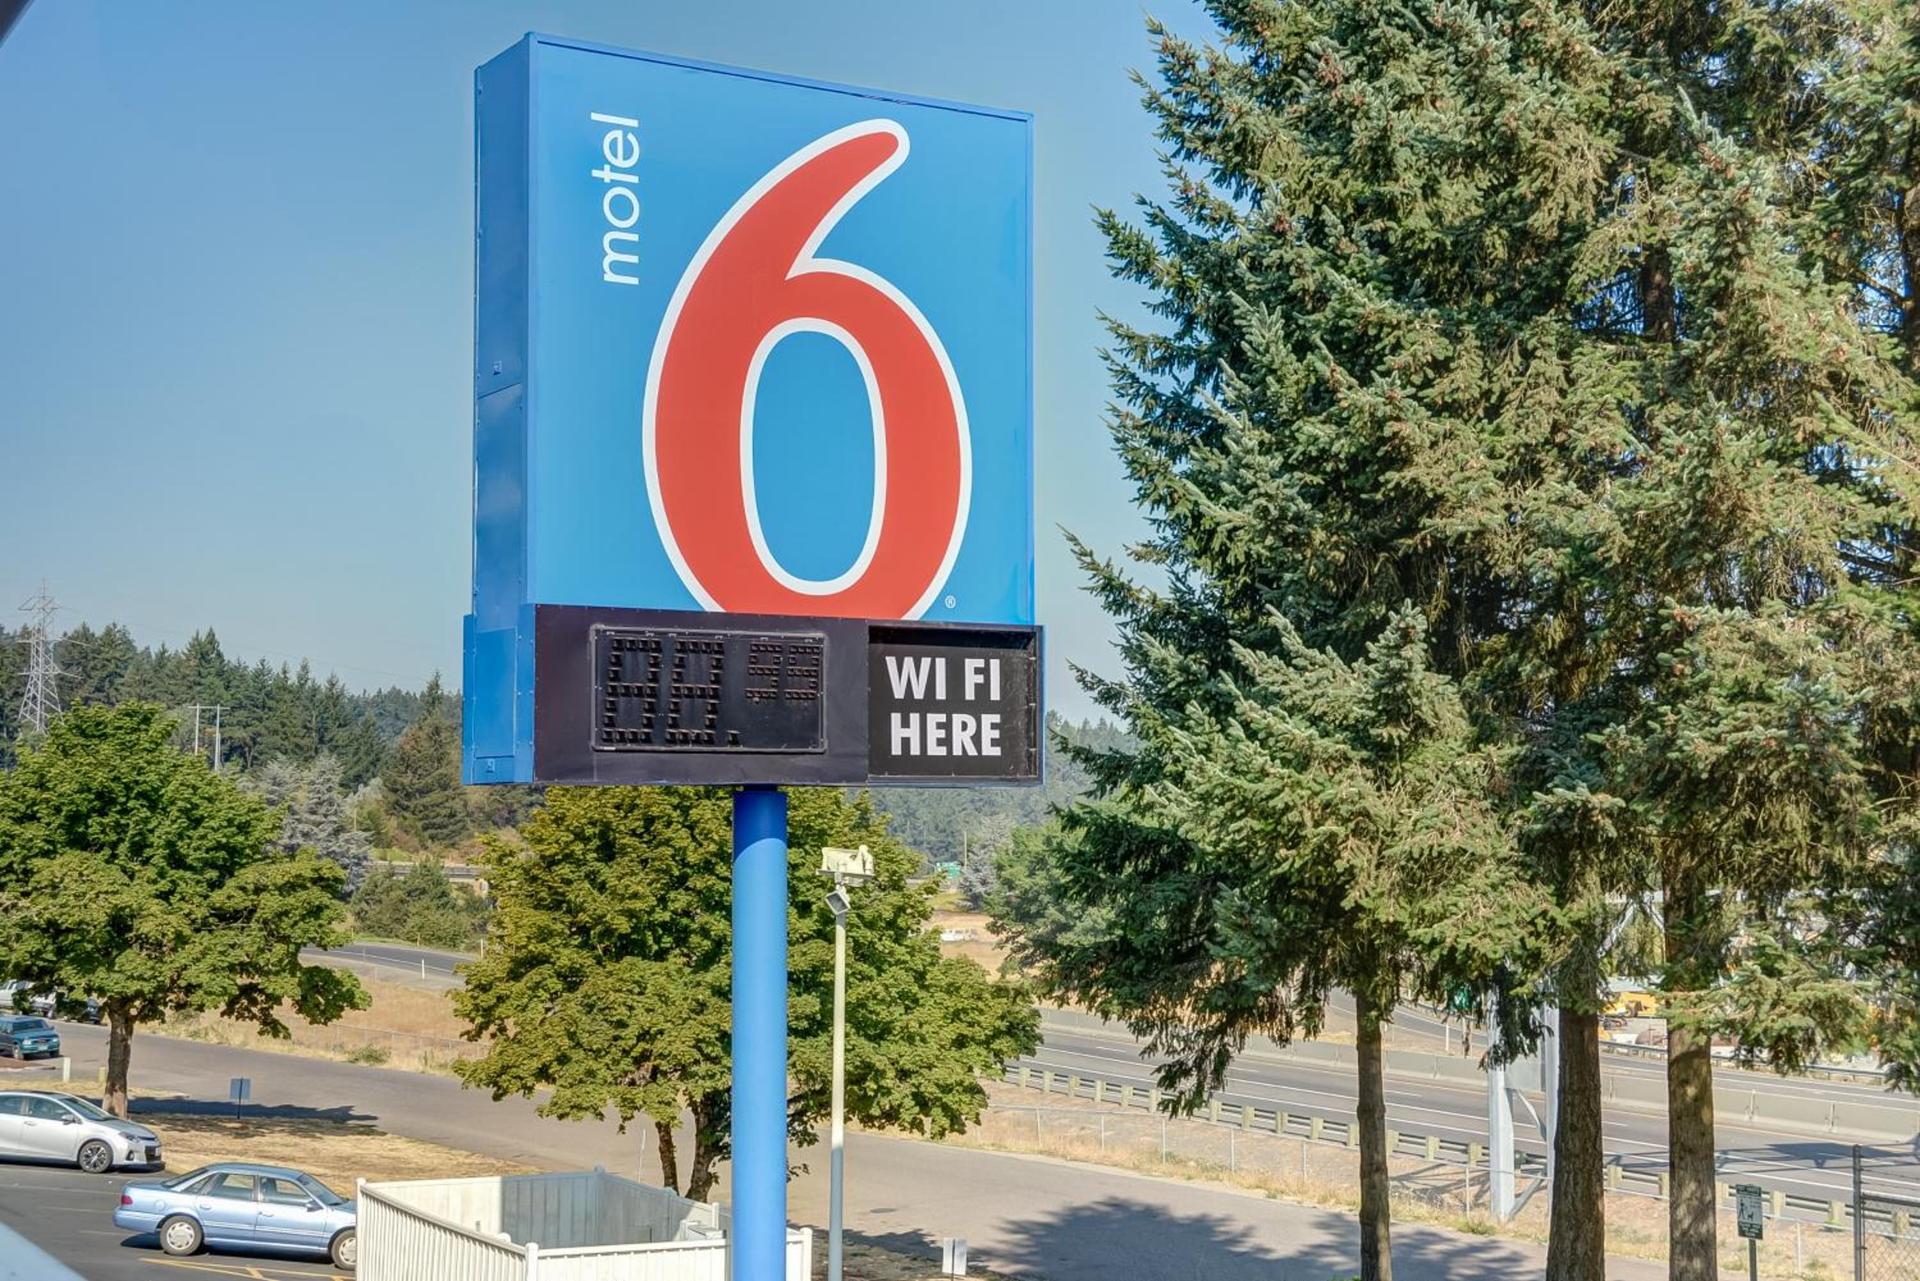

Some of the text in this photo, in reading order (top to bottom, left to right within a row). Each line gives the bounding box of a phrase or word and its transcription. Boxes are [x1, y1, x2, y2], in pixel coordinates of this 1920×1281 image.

[590, 112, 640, 286] motel
[642, 118, 973, 621] 6
[885, 655, 1001, 701] WI FI
[890, 712, 1002, 756] HERE
